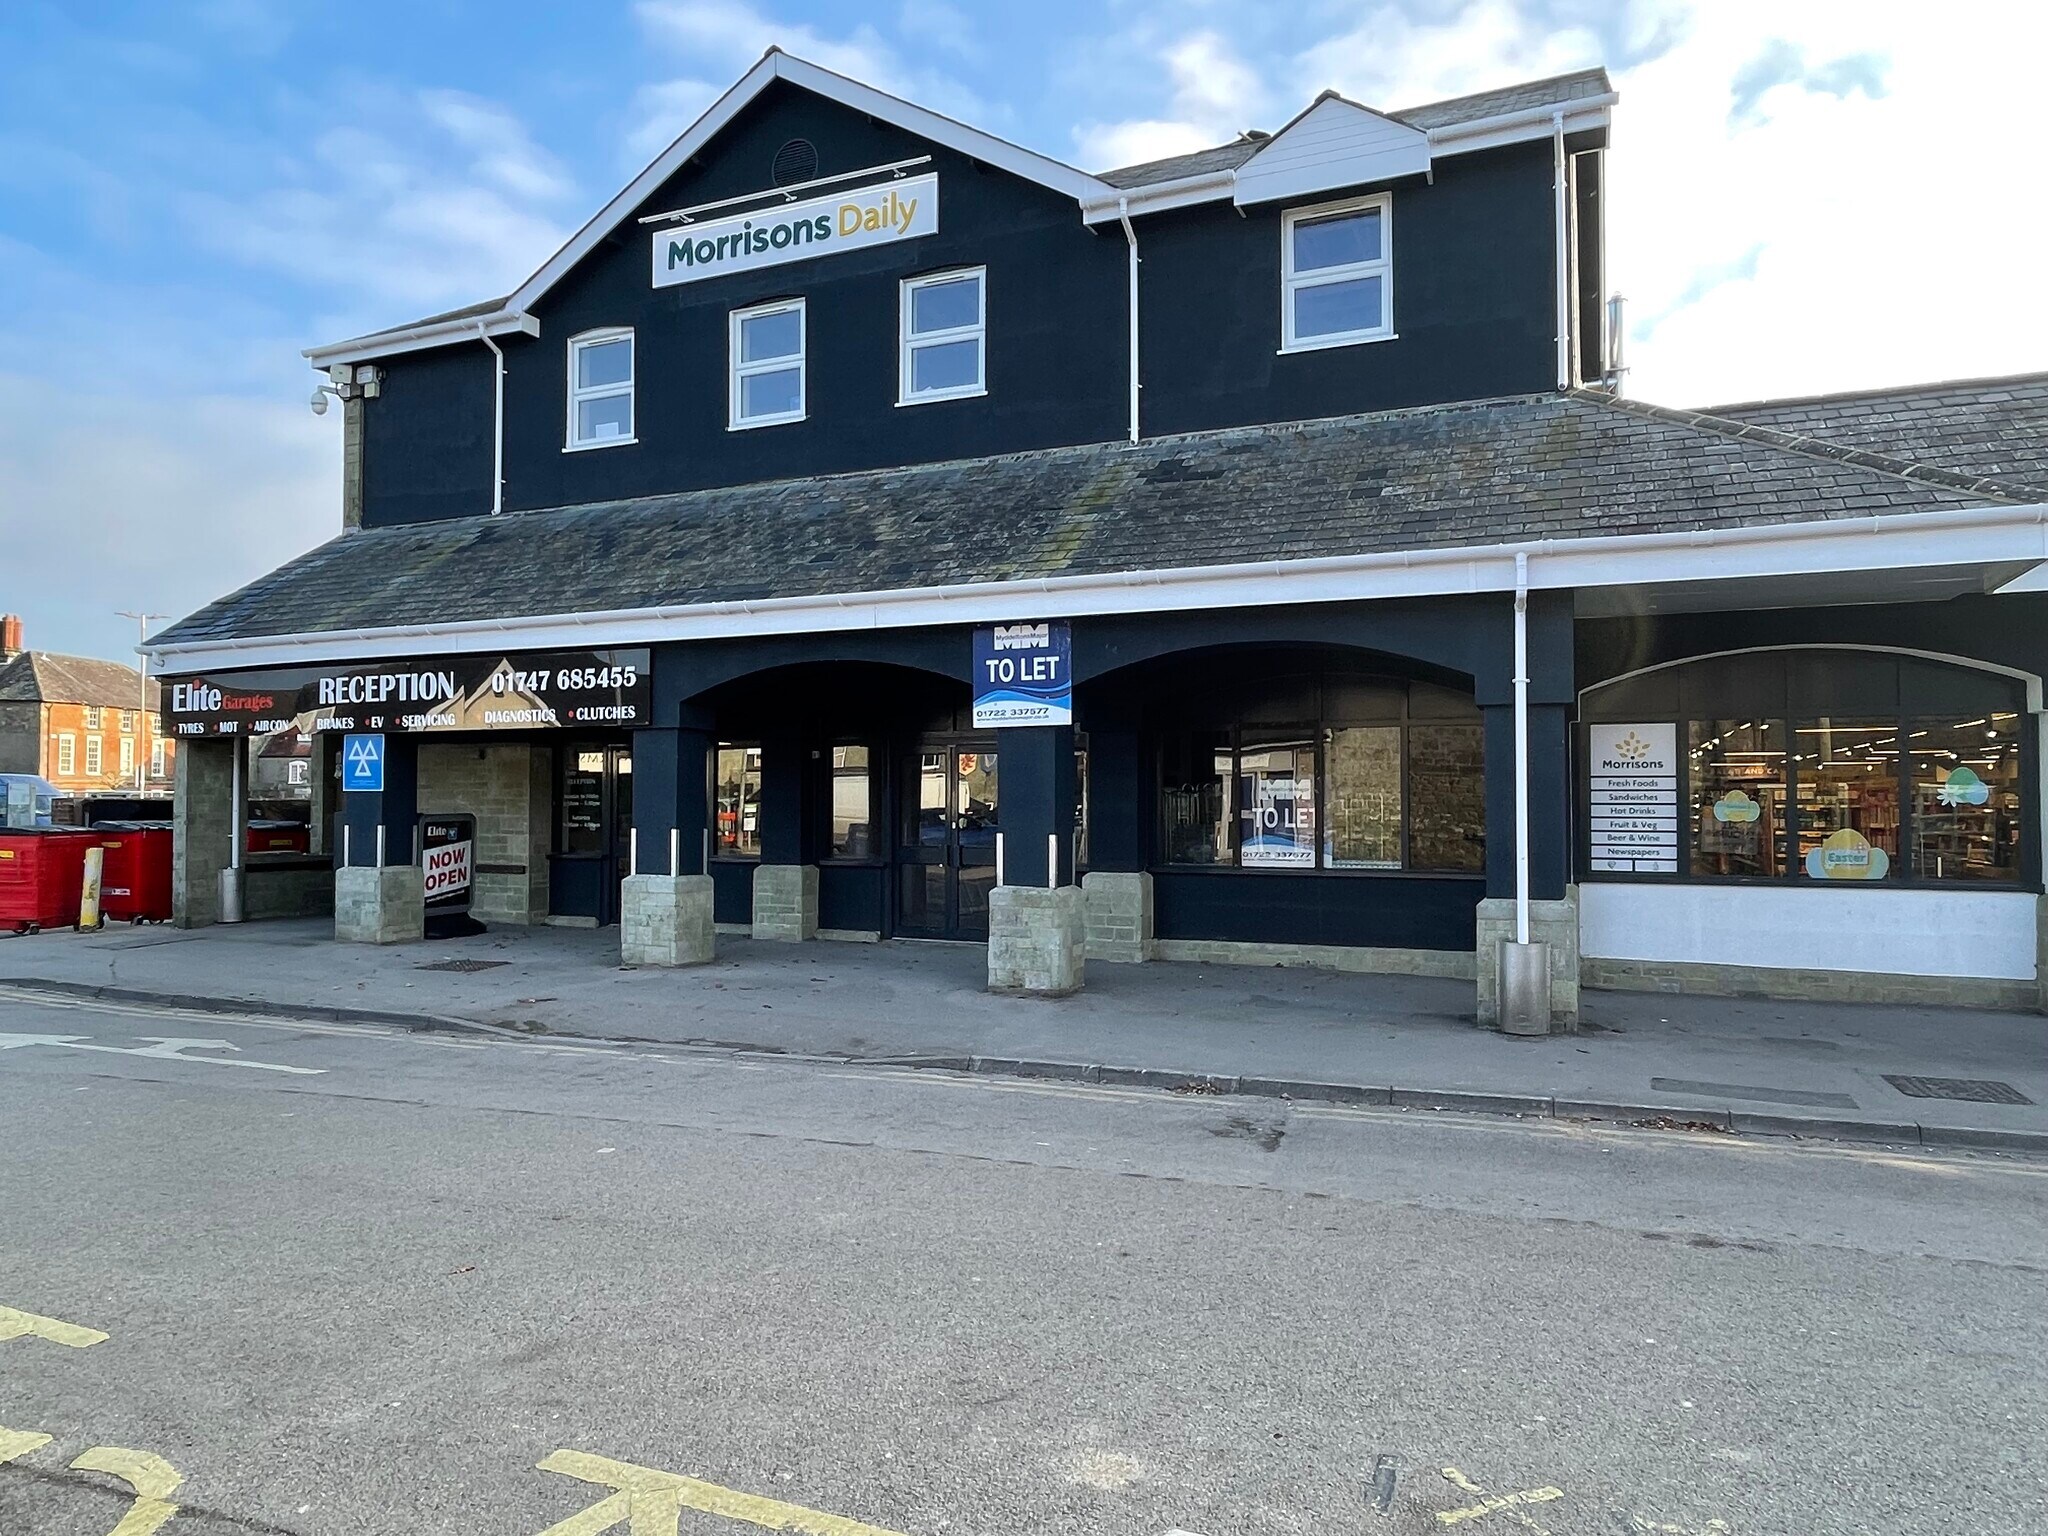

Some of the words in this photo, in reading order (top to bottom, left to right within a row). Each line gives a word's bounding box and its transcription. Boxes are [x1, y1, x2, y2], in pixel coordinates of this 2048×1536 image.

[668, 214, 831, 270] Morrisons
[839, 191, 917, 237] Daily
[986, 658, 1014, 683] TO
[1021, 656, 1059, 681] LET
[491, 670, 551, 693] 01747
[557, 665, 637, 690] 685455
[172, 679, 221, 713] Elite
[222, 694, 273, 712] Garages
[319, 671, 454, 705] RECEPTION
[178, 722, 205, 735] TYRES
[219, 721, 239, 733] MOT
[317, 717, 354, 730] BRAKES
[371, 716, 384, 728] EV
[401, 713, 456, 728] SERVICING
[484, 708, 556, 724] DIAGNOSTICS
[576, 705, 636, 721] CLUTCHES
[976, 710, 1007, 718] 01722
[1010, 707, 1049, 716] 337577
[1602, 756, 1664, 769] Morrisons
[1633, 779, 1658, 787] Foods
[1252, 808, 1279, 829] TO
[1284, 807, 1316, 828] LET
[1610, 807, 1627, 815] Hot
[1629, 807, 1656, 815] Drinks
[427, 826, 447, 837] Elite
[1610, 821, 1629, 829] Fruit
[1631, 821, 1638, 829] &
[1641, 821, 1657, 831] Veg
[1607, 834, 1626, 842] Beer
[1628, 834, 1636, 842] &
[1638, 834, 1660, 842] Wine
[429, 848, 466, 870] NOW
[1607, 848, 1660, 857] Newspapers
[1828, 852, 1866, 862] Easter
[425, 866, 468, 891] OPEN
